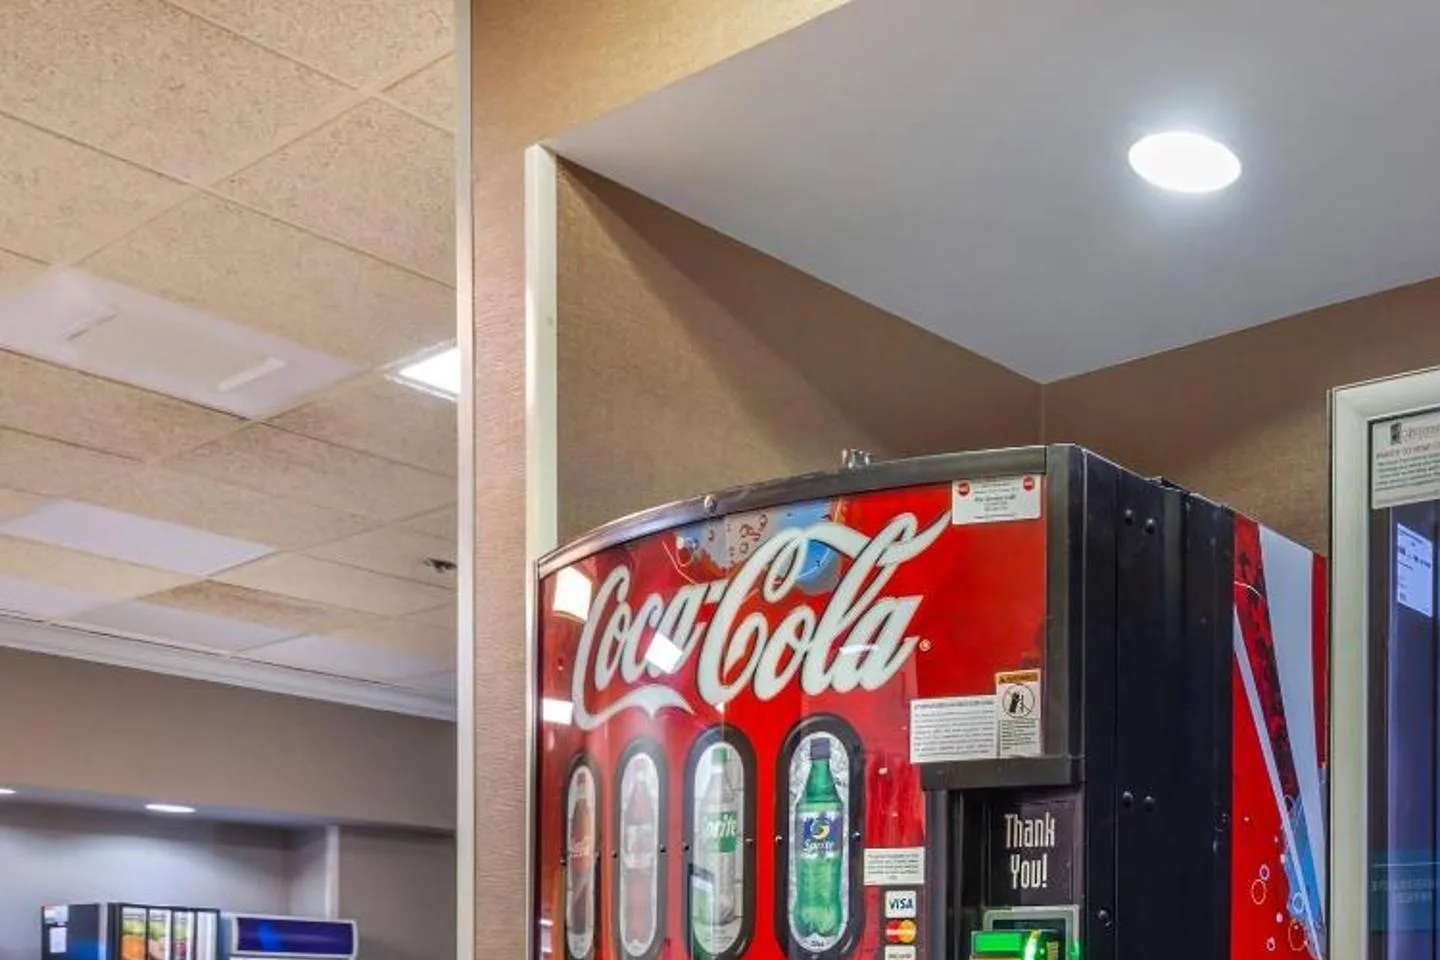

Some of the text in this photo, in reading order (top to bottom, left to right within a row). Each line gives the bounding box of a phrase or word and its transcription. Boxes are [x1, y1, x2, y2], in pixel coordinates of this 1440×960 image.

[573, 512, 953, 730] Coca-Cola
[1004, 811, 1055, 849] Thank
[1011, 853, 1048, 890] You!
[889, 898, 914, 910] VISA
